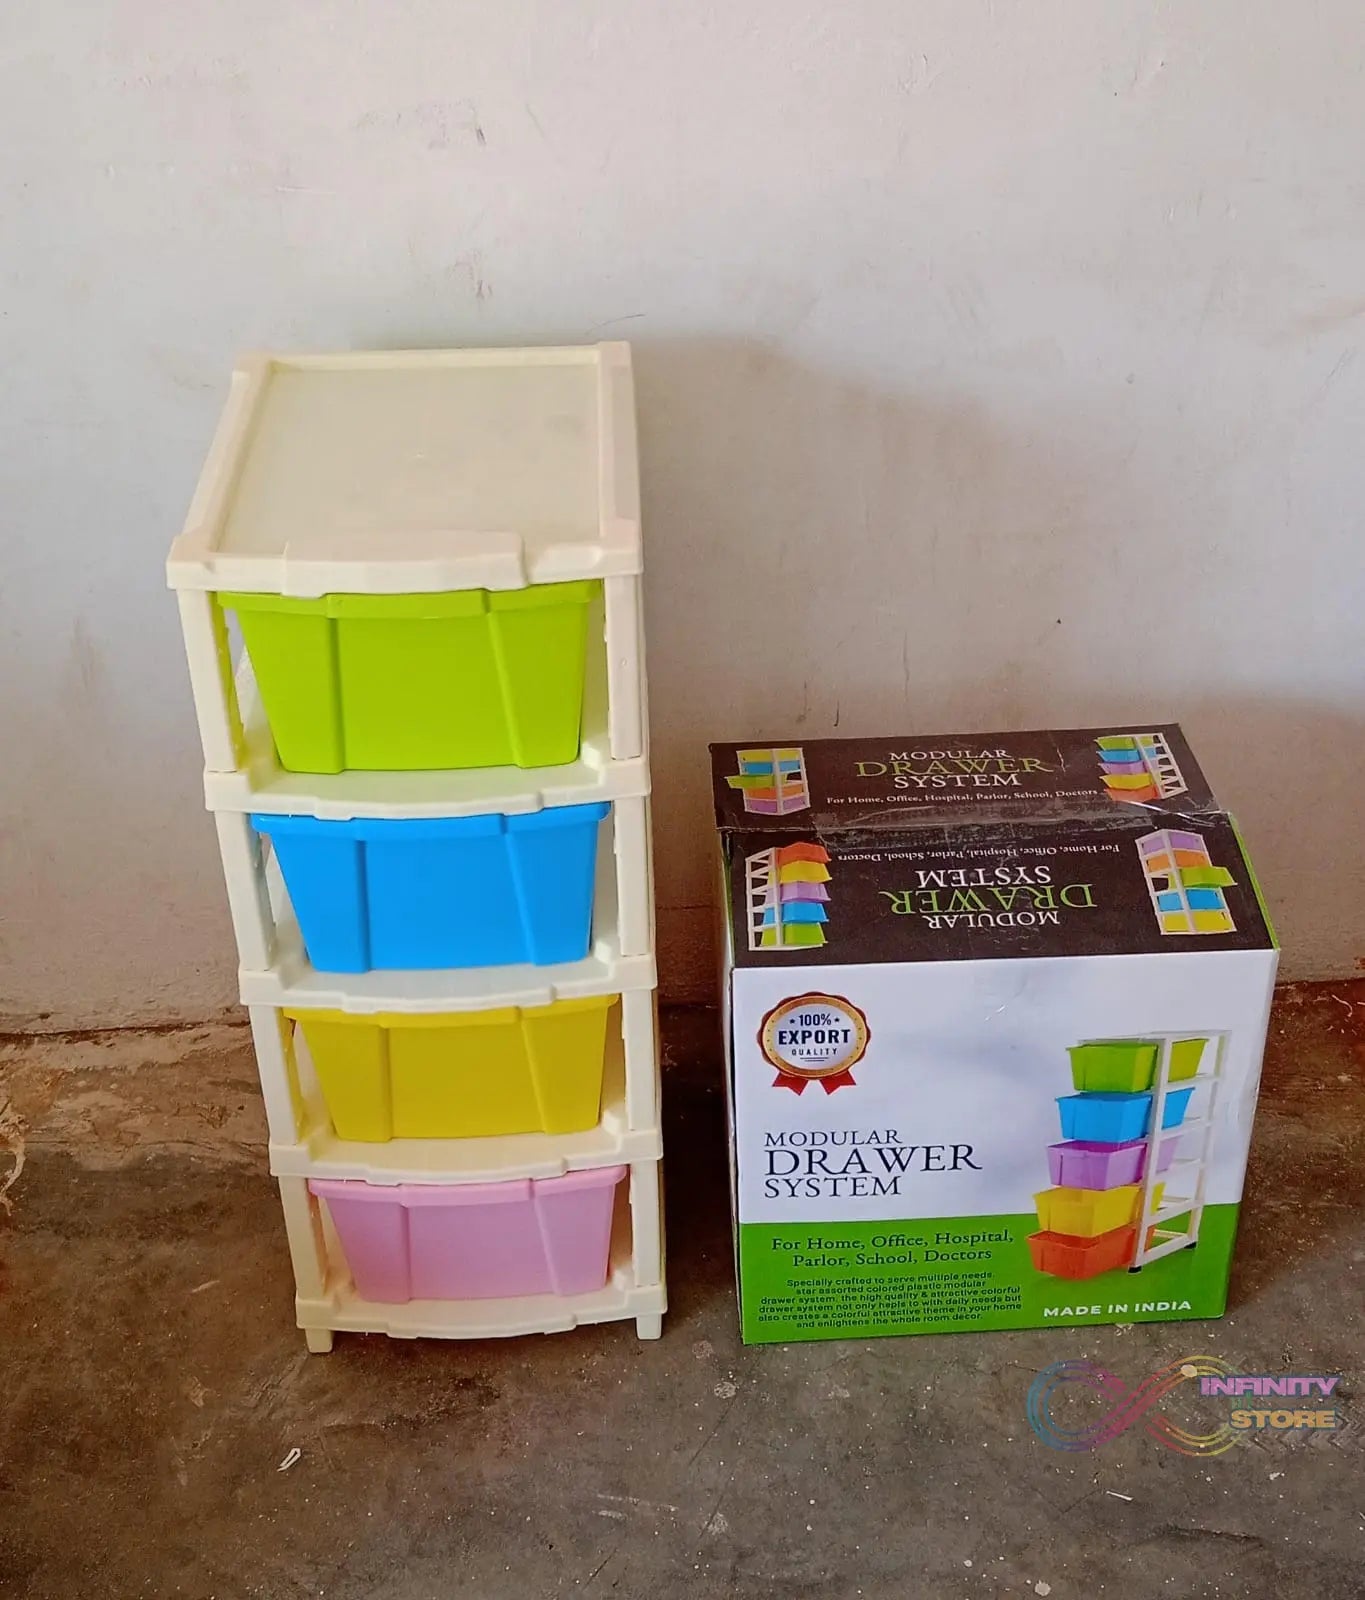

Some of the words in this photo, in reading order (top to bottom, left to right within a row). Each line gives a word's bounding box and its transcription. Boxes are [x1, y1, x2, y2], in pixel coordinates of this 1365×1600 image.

[889, 749, 1012, 760] MODULAR
[854, 757, 1054, 777] DRAWER
[894, 773, 1022, 789] SYSTEM
[848, 796, 884, 804] Home,
[925, 793, 974, 802] Hospital,
[976, 792, 1012, 800] Parlor,
[1014, 791, 1053, 799] School,
[1055, 789, 1098, 797] Doctors
[884, 852, 925, 860] School,
[927, 850, 964, 859] Parlor,
[966, 848, 1018, 857] Hospital,
[1019, 847, 1057, 856] Office,
[1059, 845, 1098, 854] Home,
[1100, 844, 1120, 853] For
[838, 853, 881, 862] Doctors
[915, 866, 1051, 888] SYSTEM
[878, 883, 1098, 914] DRAWER
[922, 911, 1060, 929] MODULAR
[799, 1013, 832, 1026] 100%
[778, 1029, 851, 1045] EXPORT
[791, 1048, 838, 1056] QUALITY
[764, 1130, 903, 1147] MODULAR
[764, 1144, 983, 1176] DRAWER
[764, 1176, 902, 1198] SYSTEM
[772, 1238, 801, 1250] For
[807, 1237, 865, 1250] Home,
[871, 1233, 928, 1247] Office,
[935, 1229, 1014, 1246] Hospital,
[792, 1254, 850, 1267] Parlor,
[856, 1252, 917, 1265] School,
[925, 1250, 992, 1262] Doctors
[787, 1278, 832, 1287] Specially
[835, 1277, 872, 1285] crafted
[918, 1273, 959, 1281] multiple
[819, 1286, 863, 1294] assorted
[866, 1283, 904, 1292] colored
[907, 1282, 941, 1291] plastic
[944, 1280, 986, 1289] modular
[761, 1297, 795, 1305] drawer
[860, 1293, 881, 1302] high
[884, 1291, 918, 1301] quality
[930, 1288, 979, 1298] attractive
[981, 1286, 1021, 1295] colorful
[783, 1312, 819, 1320] creates
[873, 1307, 920, 1317] attractive
[923, 1306, 954, 1314] theme
[969, 1304, 990, 1313] your
[993, 1303, 1021, 1311] home
[797, 1304, 833, 1312] system
[836, 1302, 852, 1310] not
[855, 1302, 876, 1310] only
[922, 1298, 943, 1306] with
[945, 1297, 968, 1305] daily
[1043, 1306, 1102, 1317] MADE
[1107, 1304, 1129, 1314] IN
[1135, 1301, 1192, 1312] INDIA
[797, 1320, 814, 1328] and
[818, 1318, 869, 1327] enlightens
[952, 1312, 983, 1320] decor.
